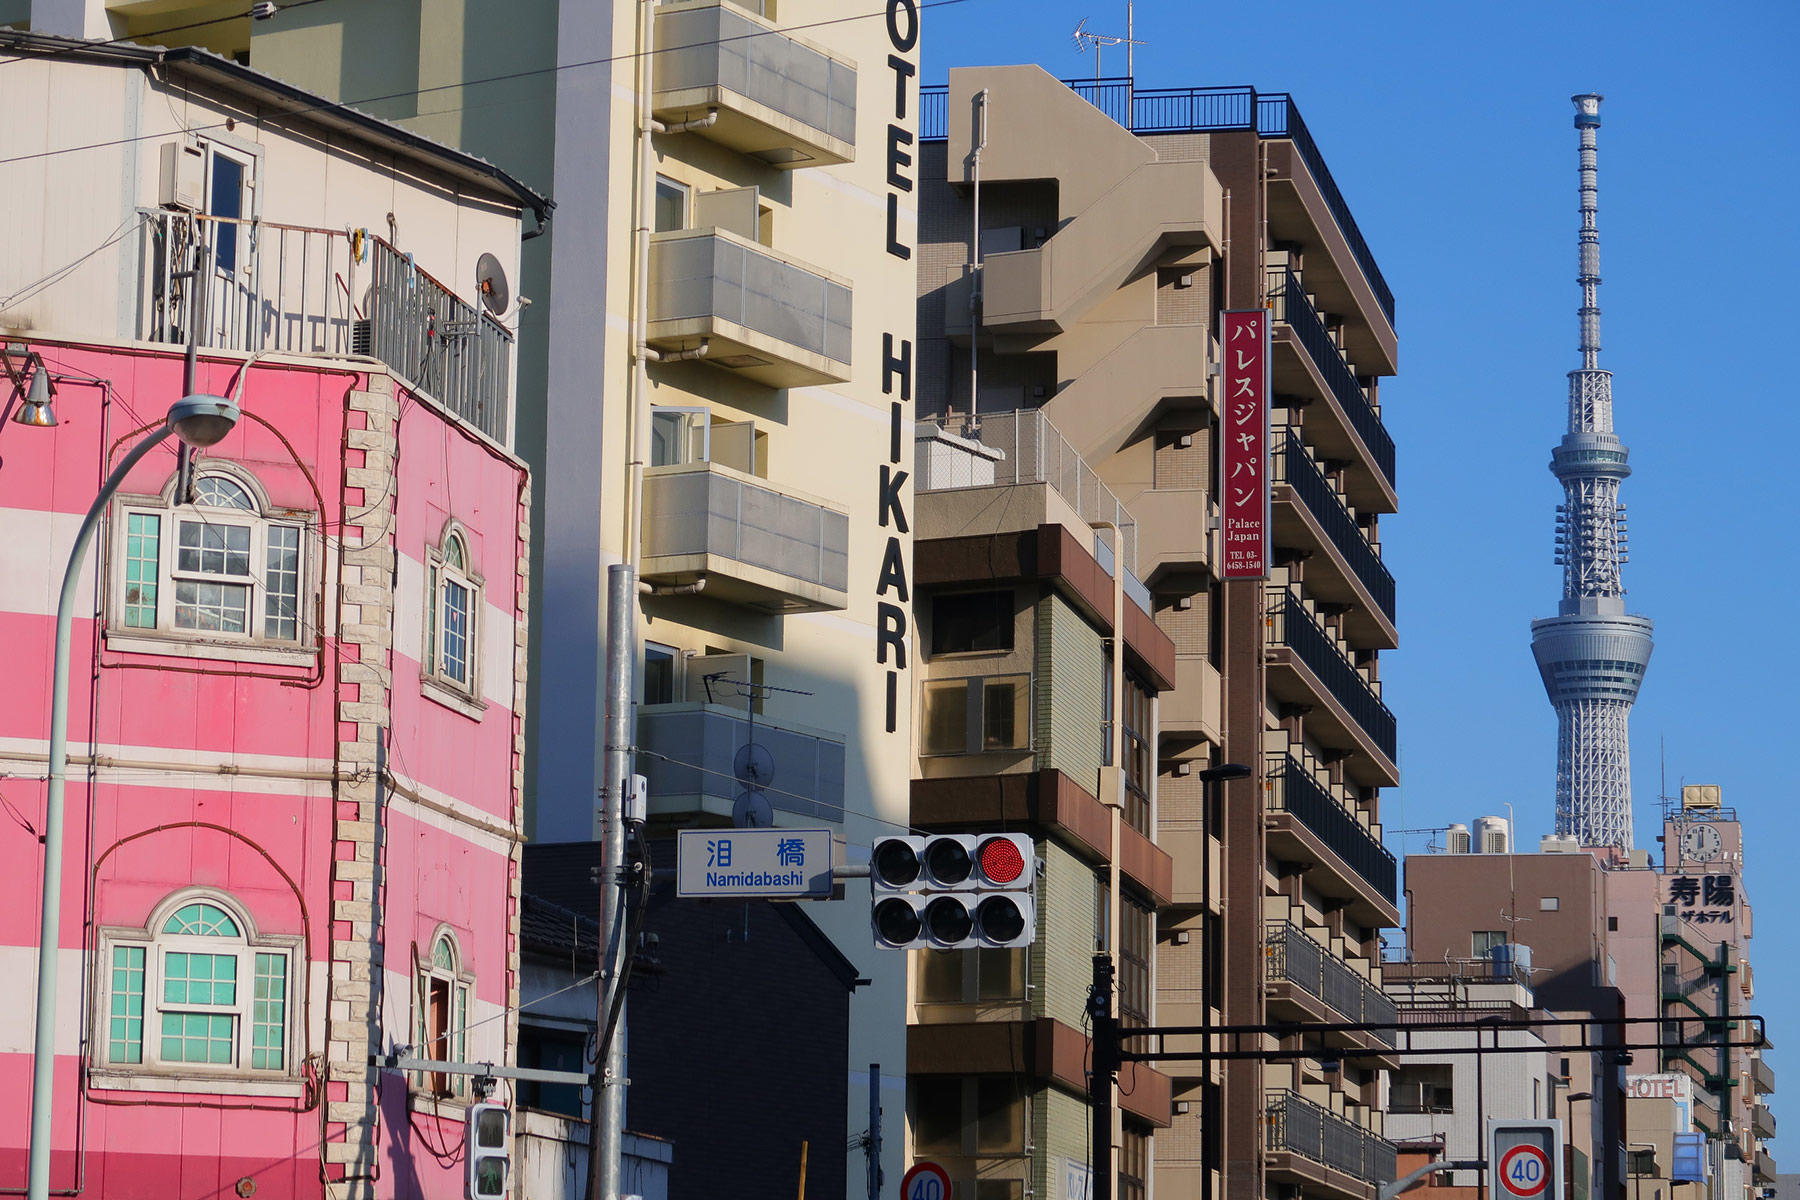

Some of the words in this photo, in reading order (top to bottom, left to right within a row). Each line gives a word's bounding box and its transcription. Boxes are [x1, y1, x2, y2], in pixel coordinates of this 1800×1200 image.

[1231, 320, 1257, 508] パレスジャパン
[875, 331, 912, 734] HIKARI
[1227, 518, 1261, 529] Palace
[1227, 530, 1260, 543] Japan
[1230, 551, 1245, 560] TEL
[706, 870, 803, 887] Namidabashi
[1669, 875, 1735, 907] 寿陽
[1680, 910, 1735, 924] ザホテル
[1626, 1078, 1686, 1098] HOTEL
[1511, 1159, 1540, 1182] 40
[912, 1178, 940, 1200] 40
